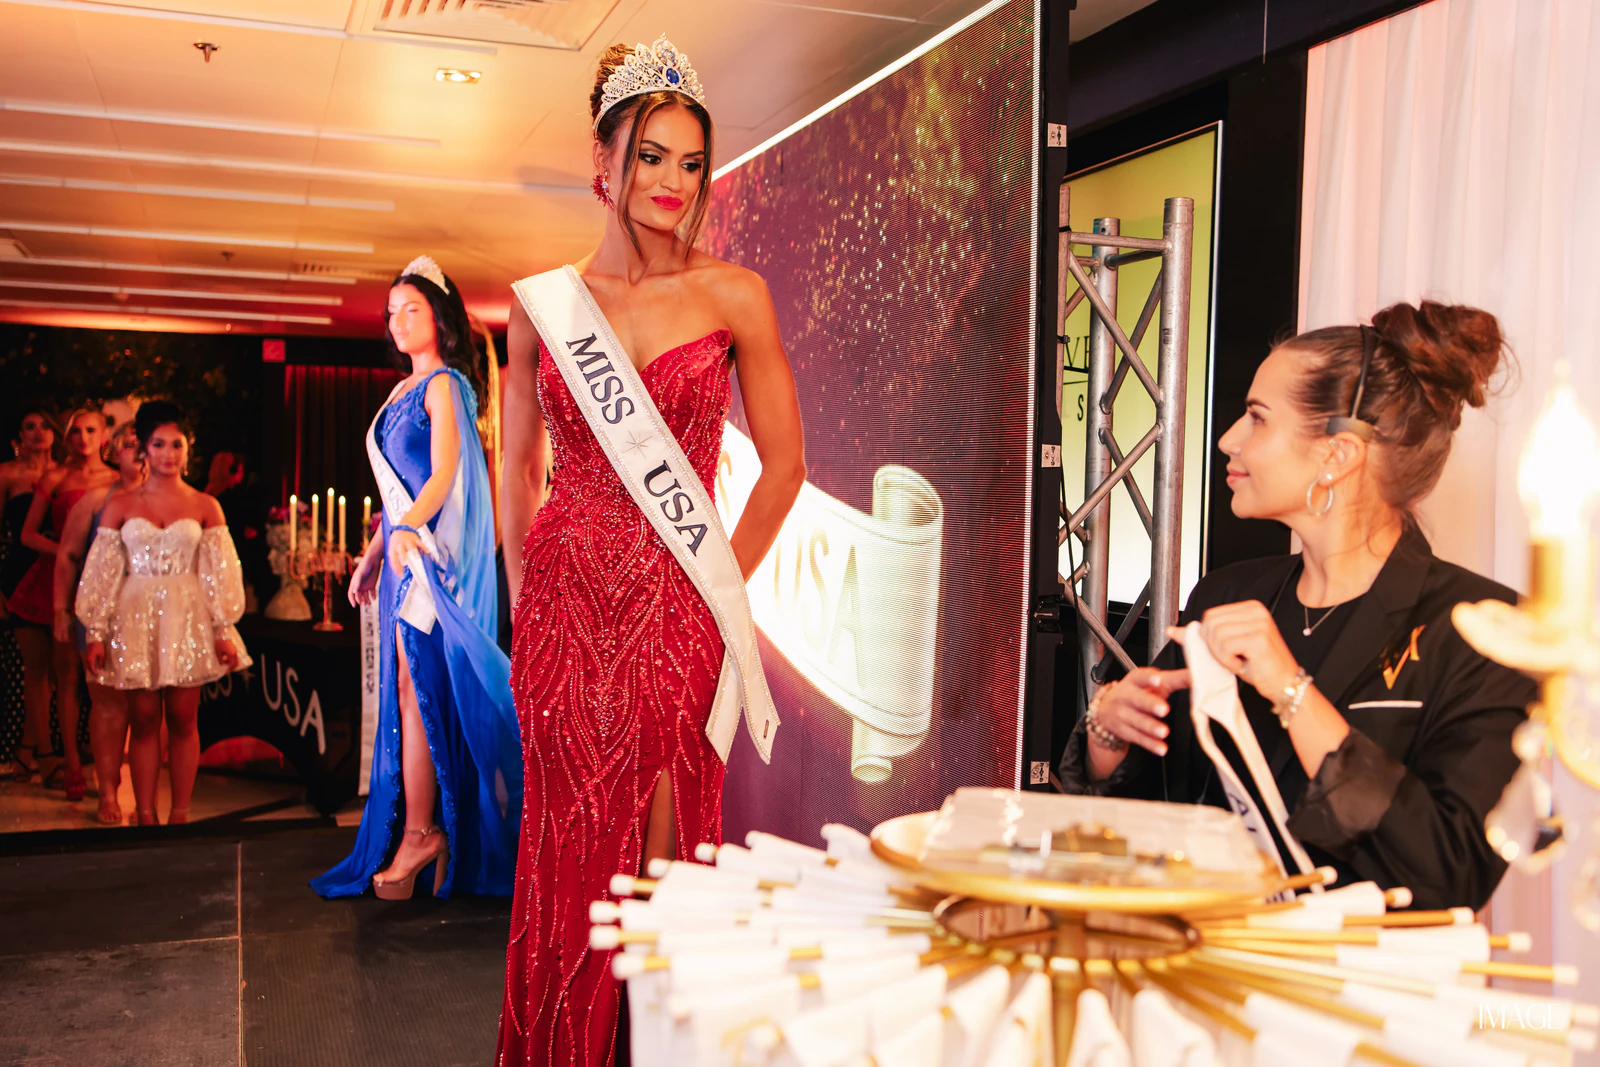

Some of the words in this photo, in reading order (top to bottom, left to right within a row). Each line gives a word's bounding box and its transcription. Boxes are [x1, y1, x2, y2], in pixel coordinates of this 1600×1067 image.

[565, 332, 635, 425] MISS
[643, 459, 708, 557] USA
[773, 519, 867, 689] USA
[261, 653, 326, 755] USA
